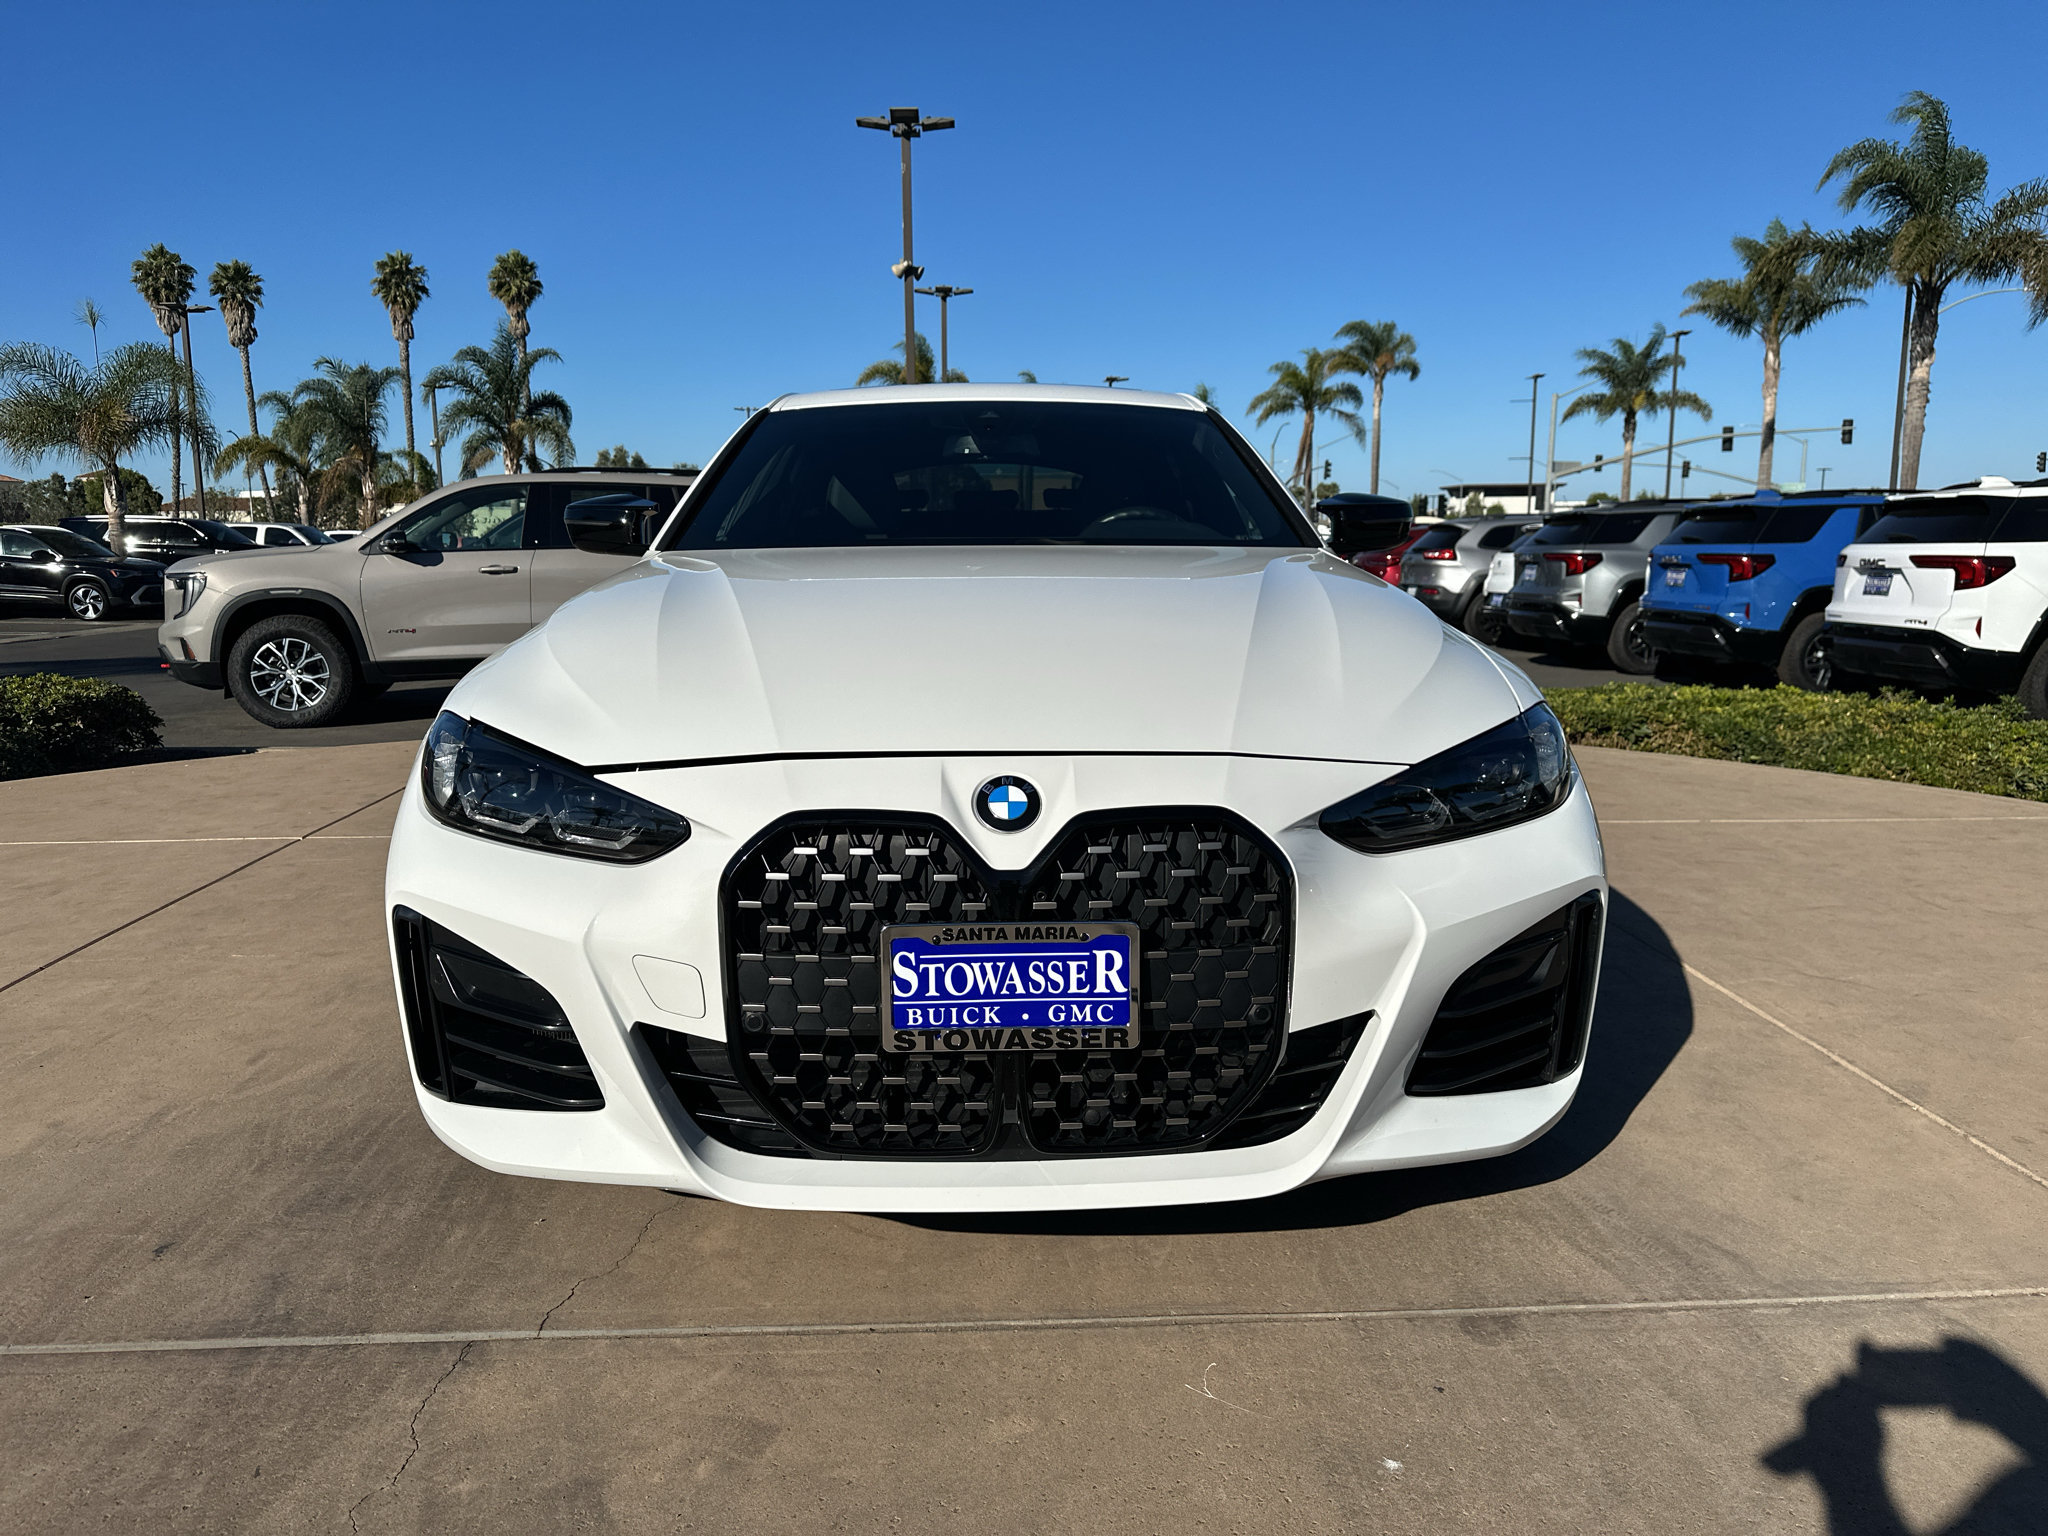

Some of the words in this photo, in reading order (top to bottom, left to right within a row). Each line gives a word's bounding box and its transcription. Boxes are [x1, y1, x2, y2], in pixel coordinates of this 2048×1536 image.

[982, 777, 1035, 794] BMW
[942, 926, 1008, 942] SANTA
[1014, 926, 1079, 941] MARIA
[892, 949, 1128, 997] STOWASSER
[906, 1006, 1001, 1025] BUICK
[1048, 1004, 1114, 1023] GMC
[893, 1028, 1129, 1051] STOWASSER
